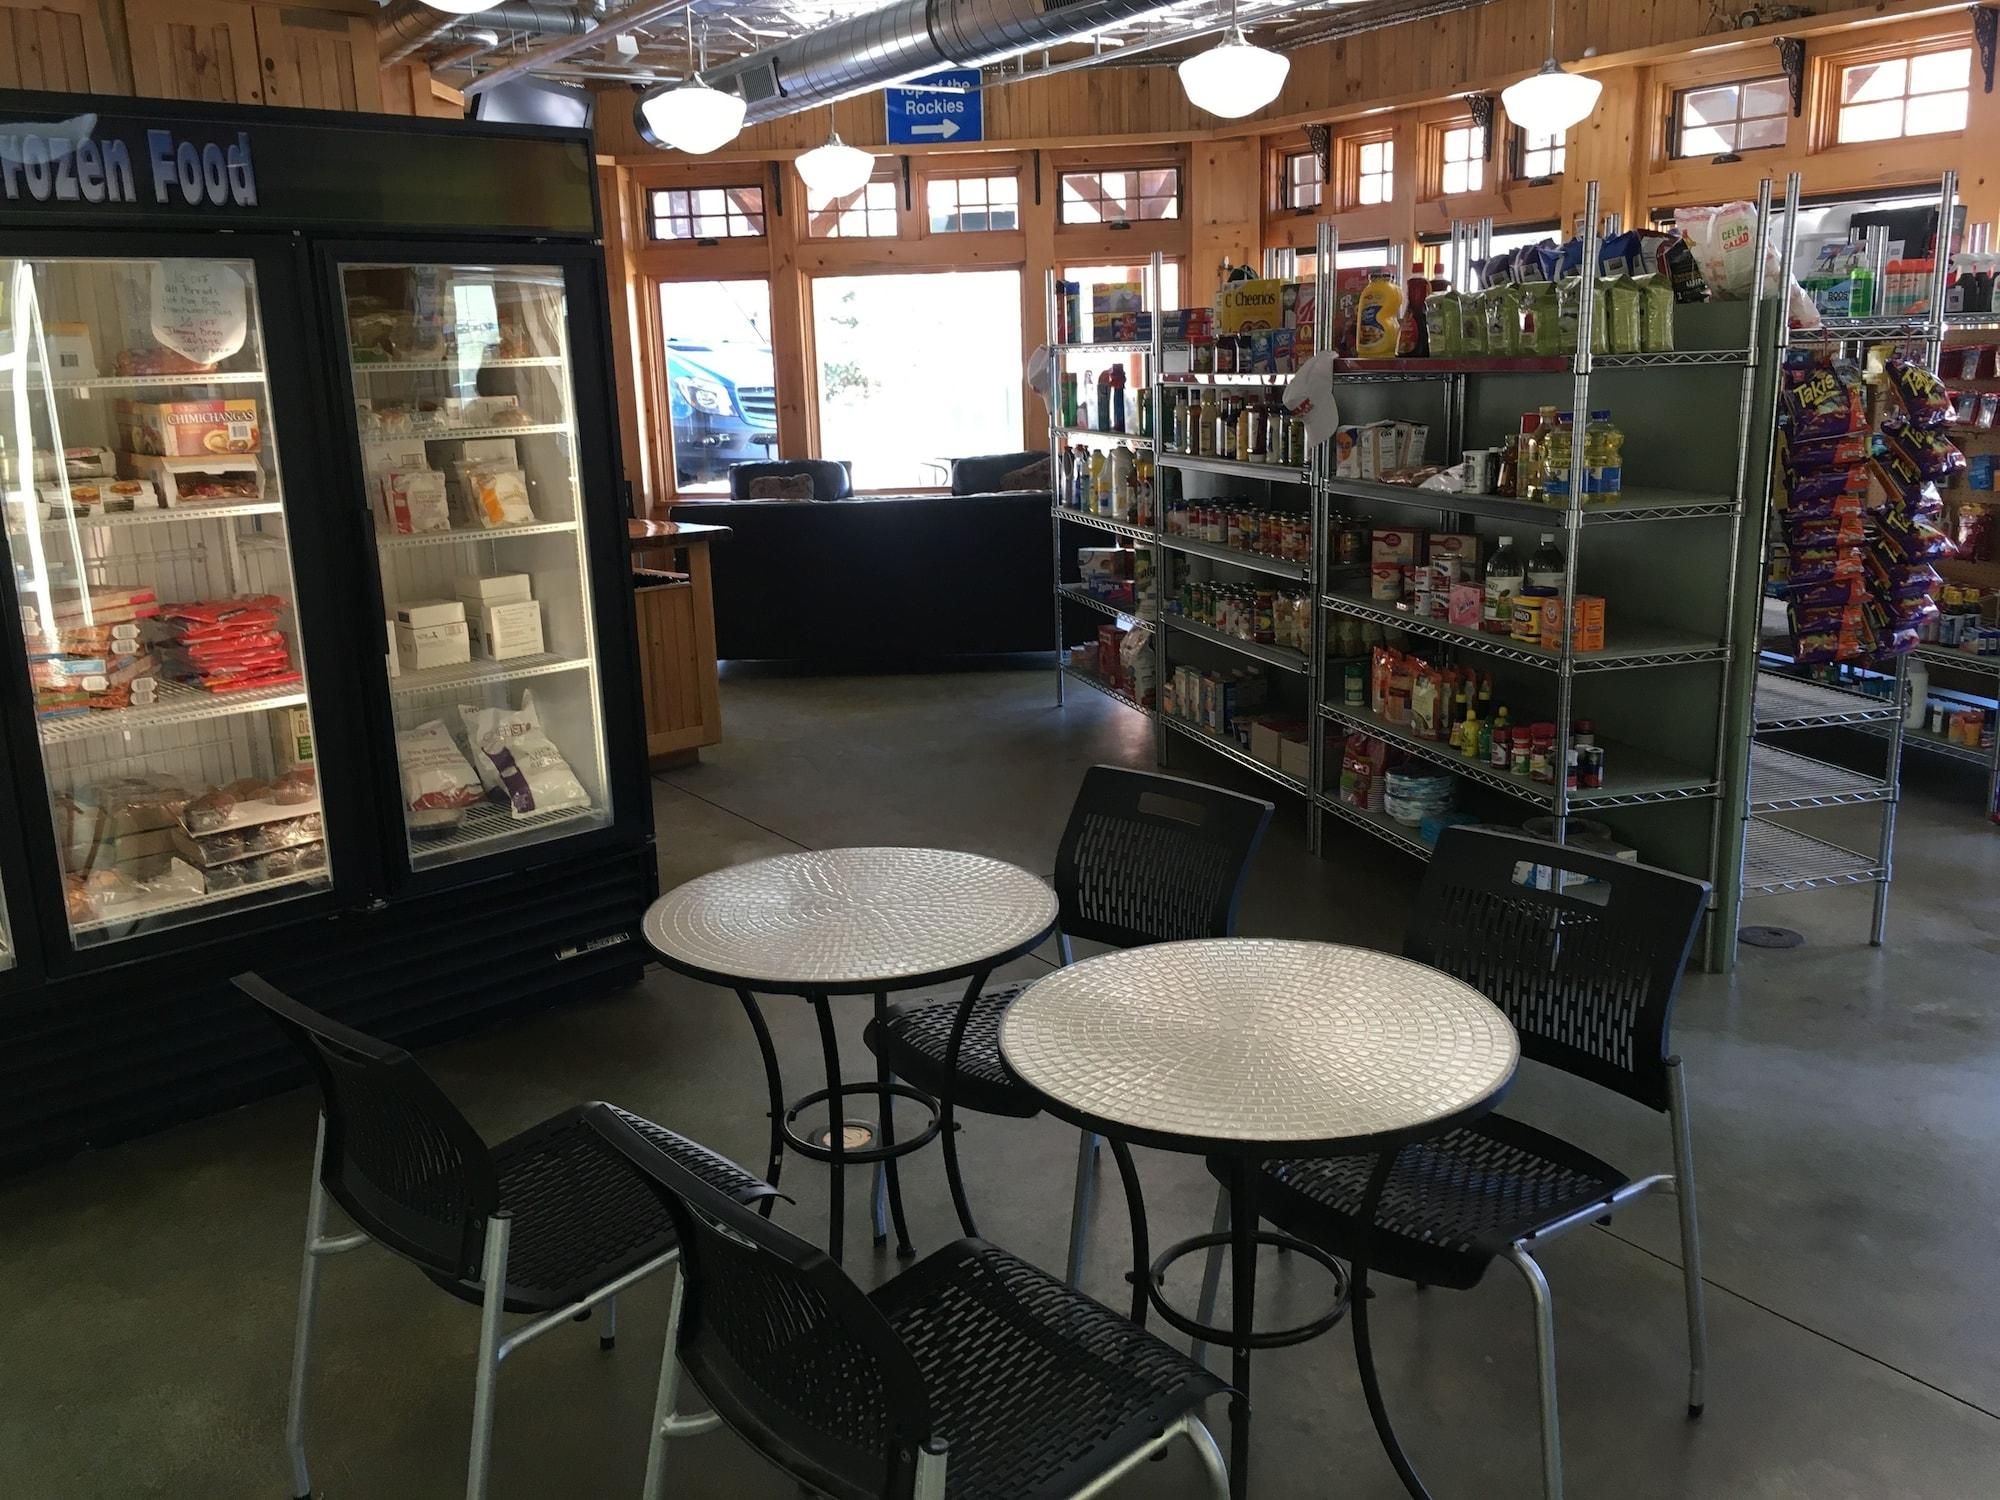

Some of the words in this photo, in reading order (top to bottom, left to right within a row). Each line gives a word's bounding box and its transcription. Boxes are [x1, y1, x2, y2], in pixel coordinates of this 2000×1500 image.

[905, 99, 965, 115] Rockies
[0, 134, 137, 203] rozen
[147, 129, 258, 206] Food
[1235, 291, 1275, 307] Cheerios
[1792, 373, 1836, 408] Takis
[167, 408, 254, 425] CHIMICHANGAS
